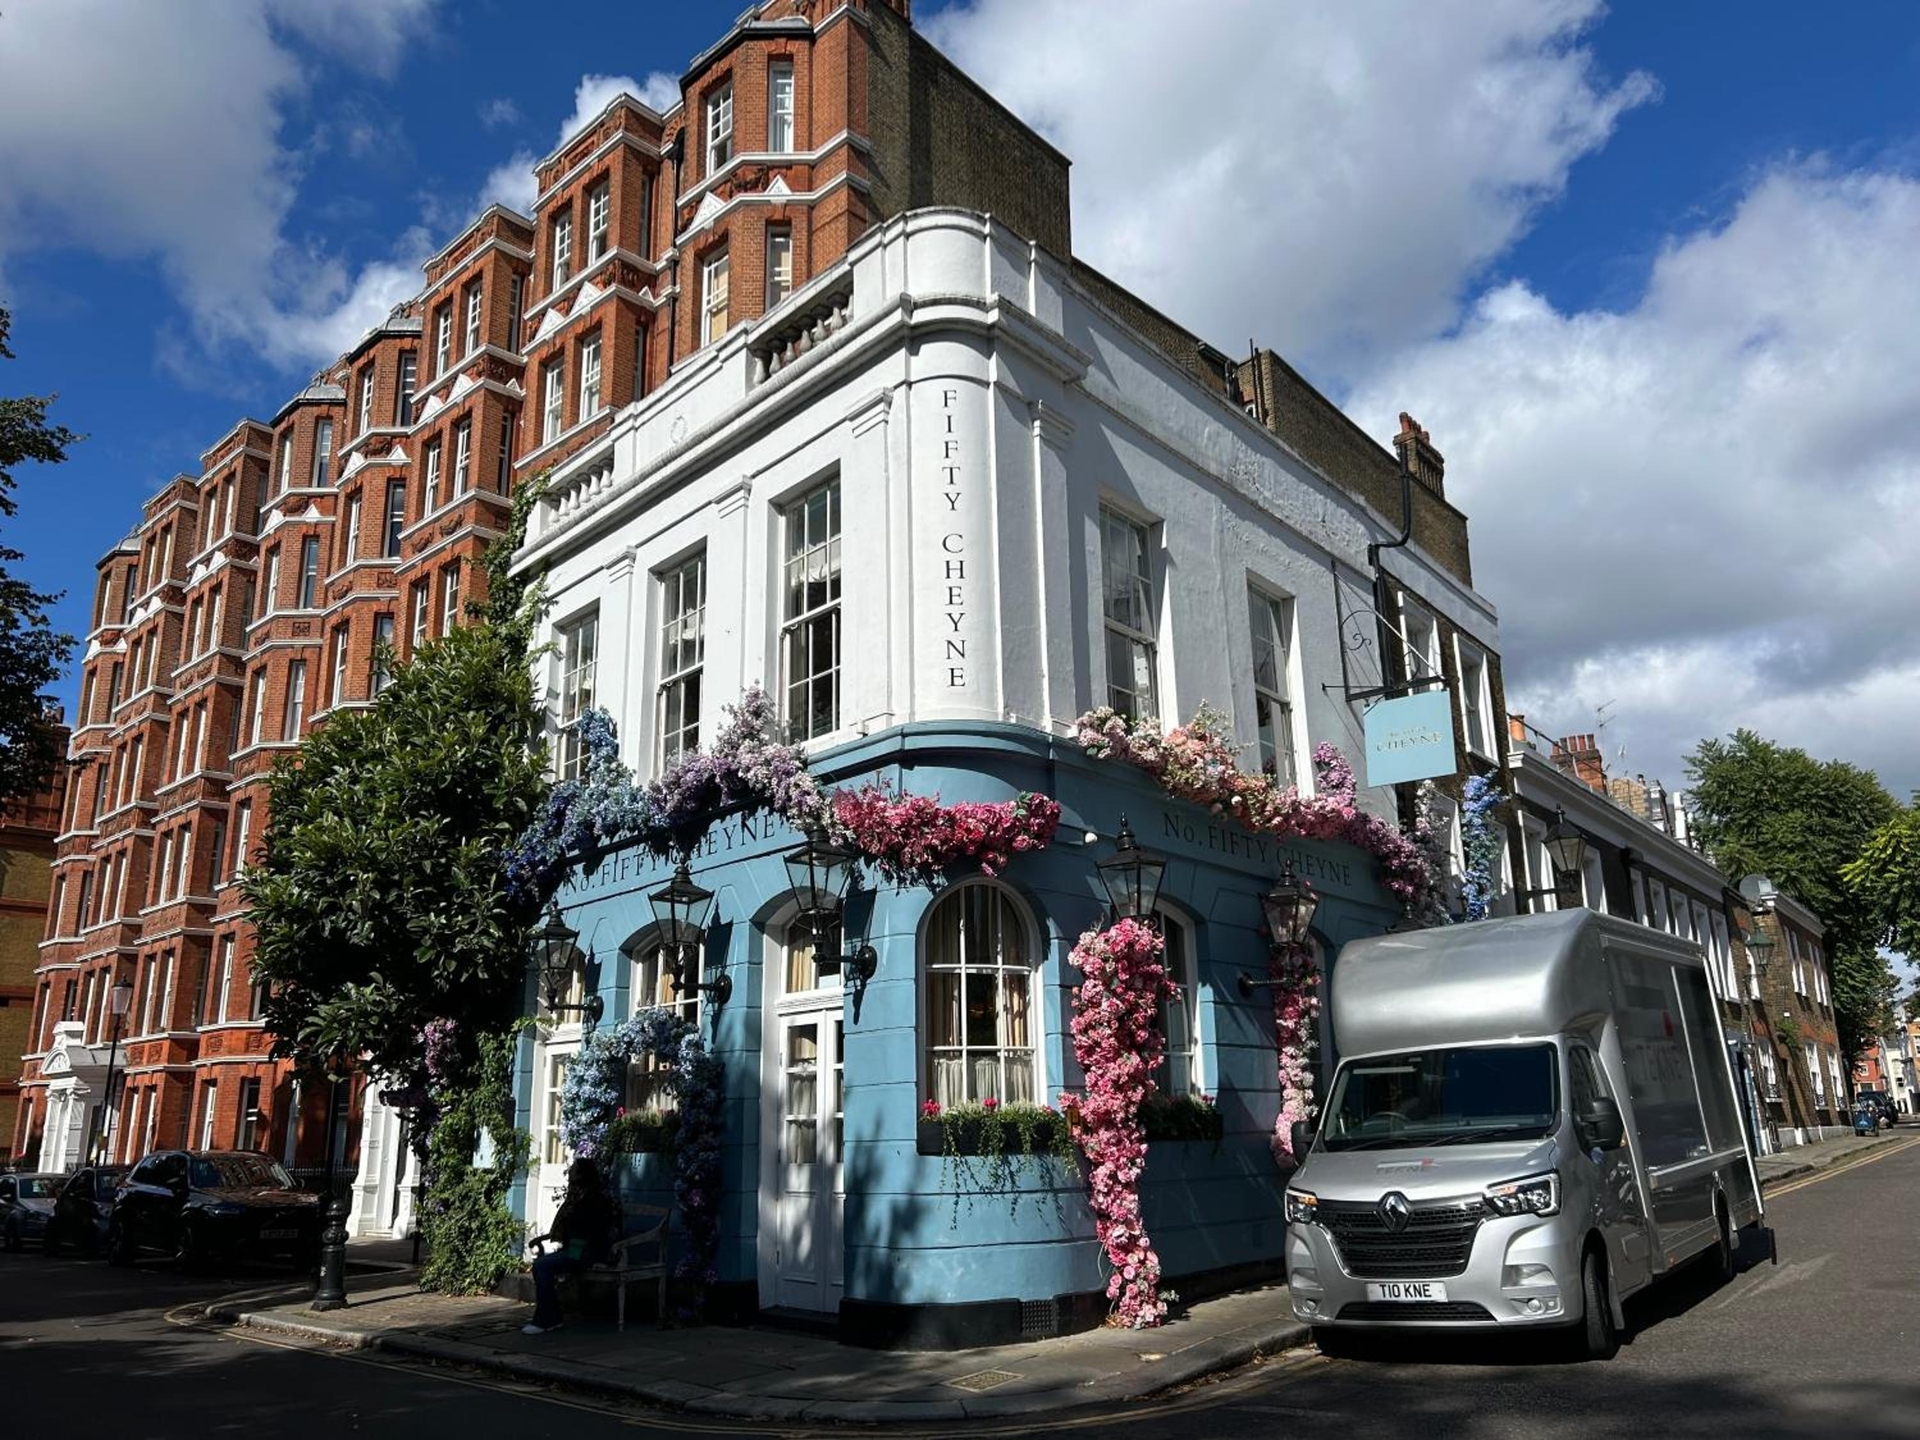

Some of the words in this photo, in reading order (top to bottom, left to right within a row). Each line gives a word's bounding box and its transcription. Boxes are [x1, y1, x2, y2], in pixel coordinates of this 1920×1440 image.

[941, 389, 962, 511] FIFTY
[941, 533, 967, 687] CHEYNE
[601, 850, 659, 887] FIFTY
[1164, 812, 1203, 846] No.
[1207, 826, 1270, 863] FIFTY
[1276, 845, 1351, 887] CHEYNE
[1403, 1283, 1432, 1298] KNE
